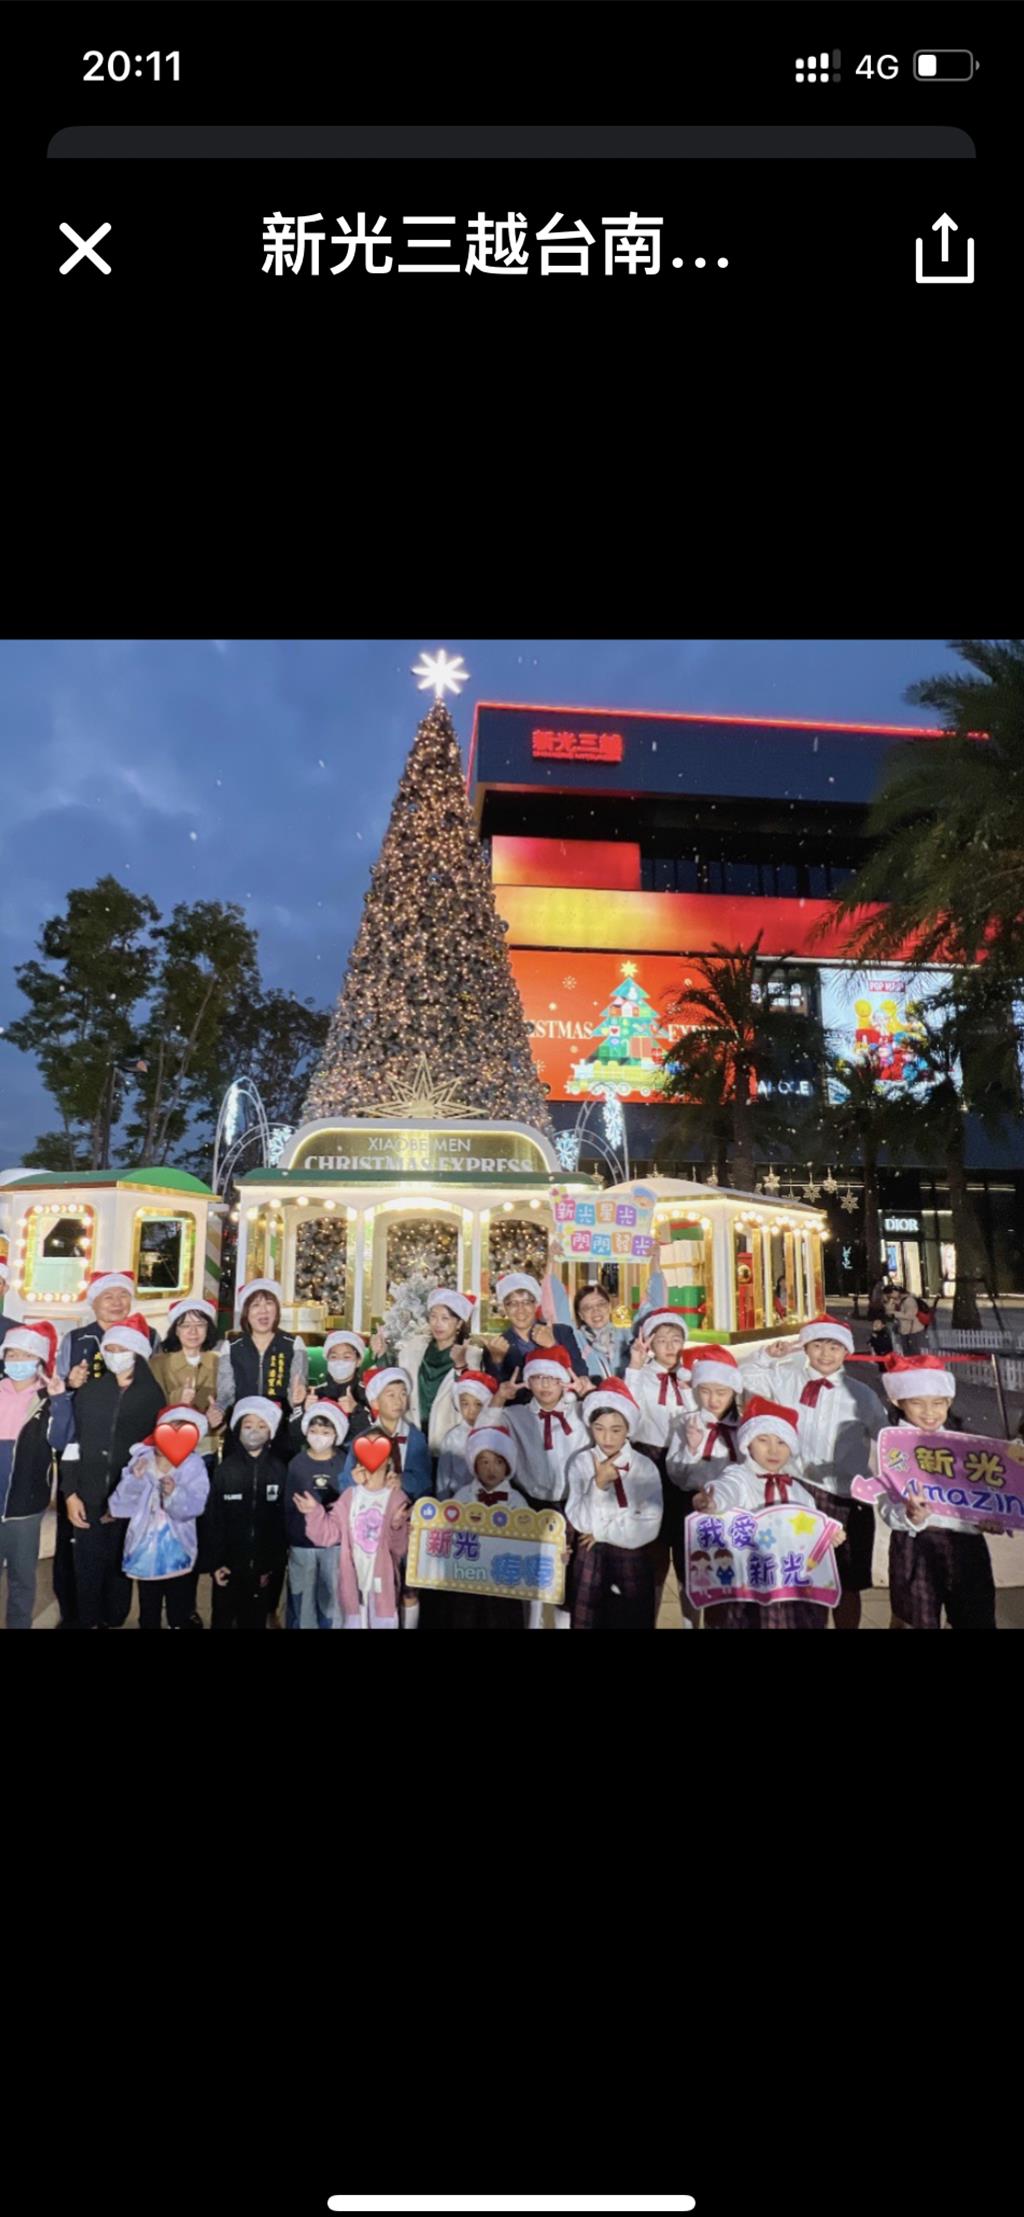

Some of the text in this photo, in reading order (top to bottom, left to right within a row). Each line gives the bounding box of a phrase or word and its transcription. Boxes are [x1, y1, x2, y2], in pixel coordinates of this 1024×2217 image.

[304, 1156, 534, 1173] CHRISTMAS EXPRESS
[885, 1218, 919, 1231] DIOR
[915, 1446, 1006, 1488] 新光
[427, 1528, 480, 1561] 新光
[697, 1514, 757, 1549] 我愛
[454, 1563, 488, 1581] hen
[749, 1551, 811, 1588] 新光
